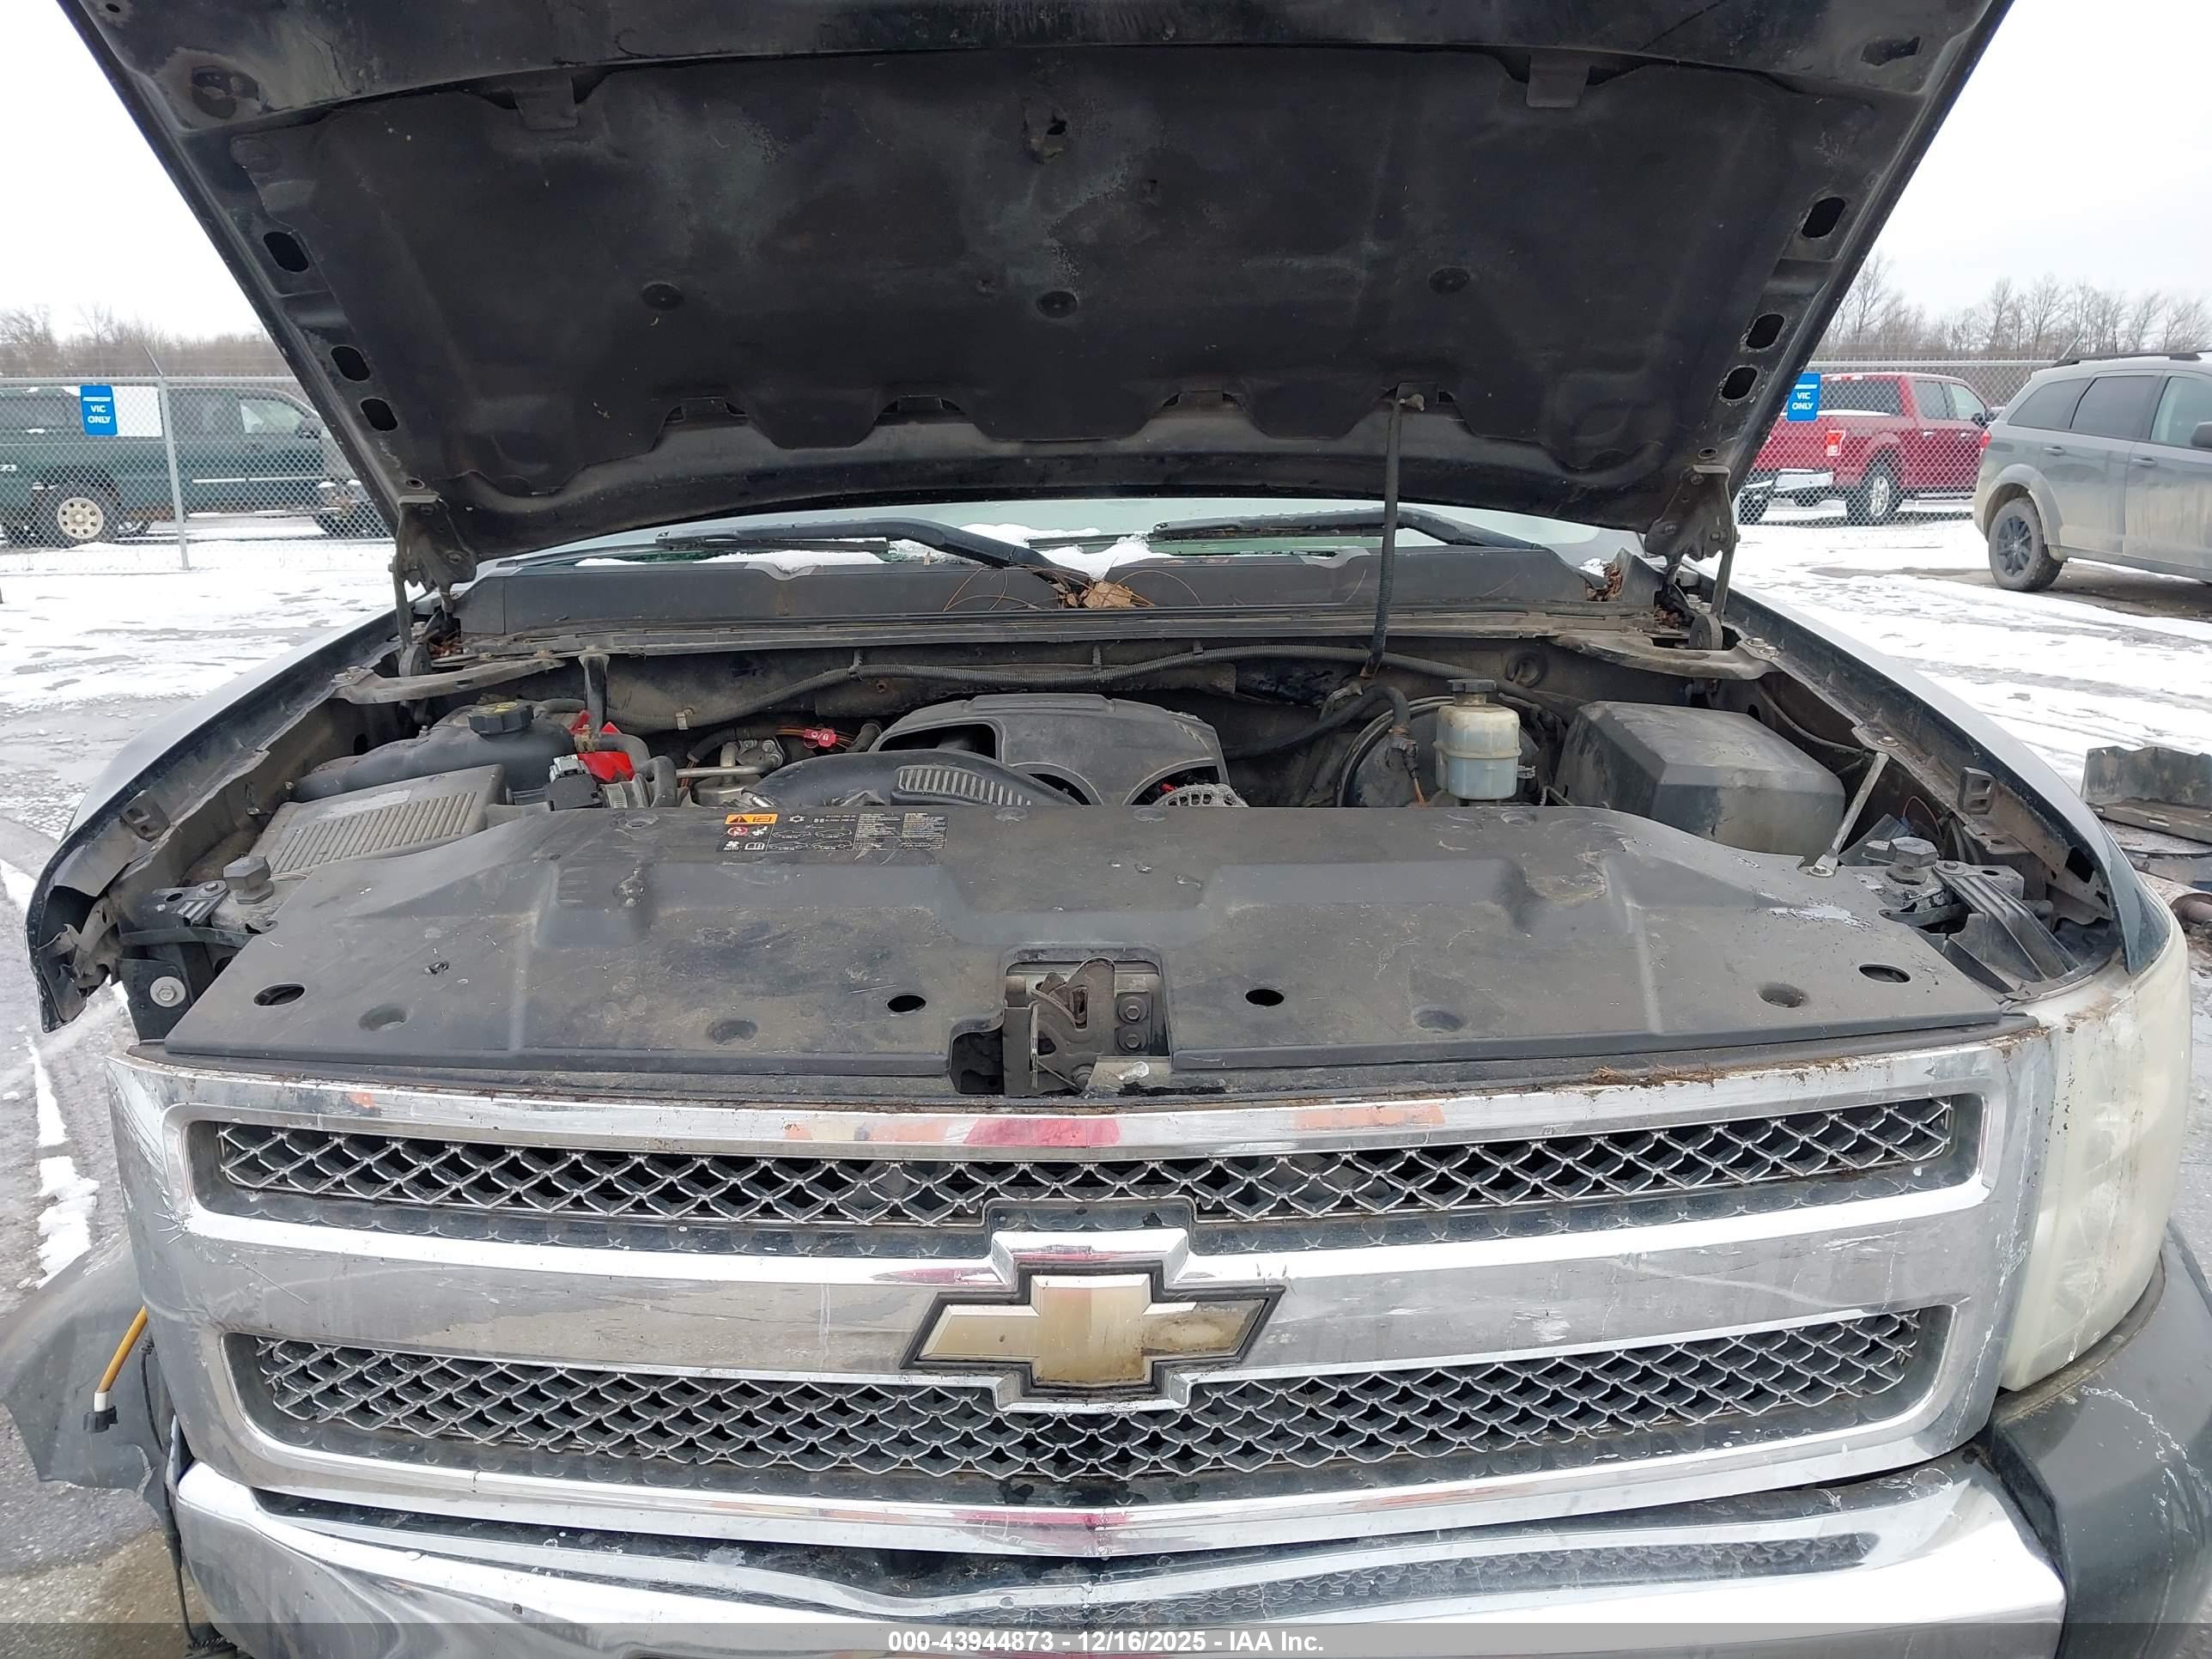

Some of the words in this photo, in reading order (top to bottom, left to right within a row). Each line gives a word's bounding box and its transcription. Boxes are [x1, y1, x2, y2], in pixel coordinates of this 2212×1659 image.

[1796, 392, 1811, 400] VIC
[90, 404, 106, 413] VIC
[1791, 402, 1814, 410] ONLY
[87, 415, 111, 424] ONLY
